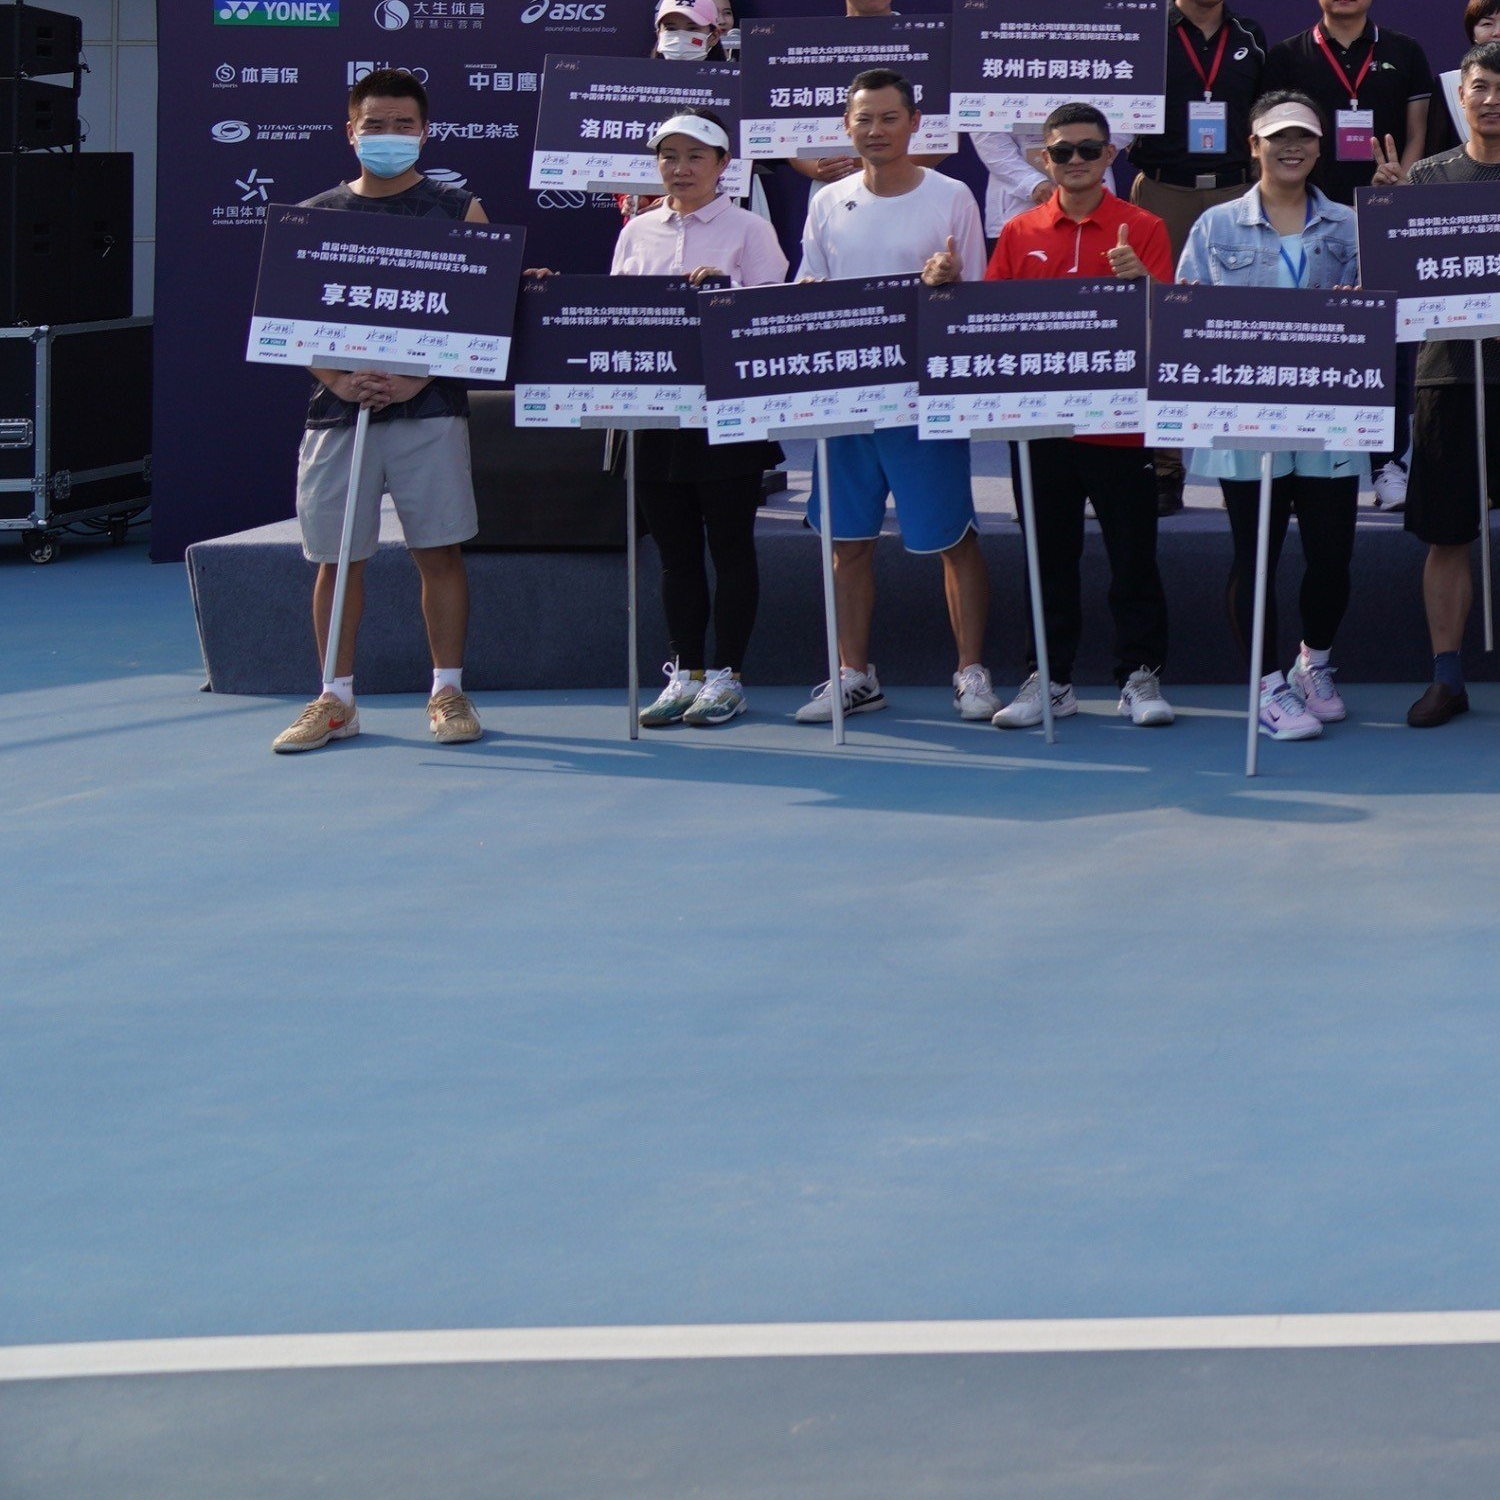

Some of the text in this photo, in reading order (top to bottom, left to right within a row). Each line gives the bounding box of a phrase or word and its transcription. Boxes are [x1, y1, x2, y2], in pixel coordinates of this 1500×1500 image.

[263, 1, 332, 22] YONEX
[414, 1, 485, 16] 大生体育
[414, 19, 484, 30] 智慧运营商
[241, 67, 299, 84] 体育保
[982, 58, 1134, 79] 郑州市网球协会
[469, 71, 545, 92] 中国鹰
[770, 85, 923, 108] 迈动网球
[212, 206, 268, 218] 中国体育
[321, 283, 450, 315] 享受网球队
[567, 350, 677, 373] 一网情深队
[735, 344, 906, 379] TBH欢乐网球队
[927, 349, 1136, 379] 春夏秋冬网球俱乐部
[1158, 362, 1385, 389] 汉台.北龙湖网球中心队
